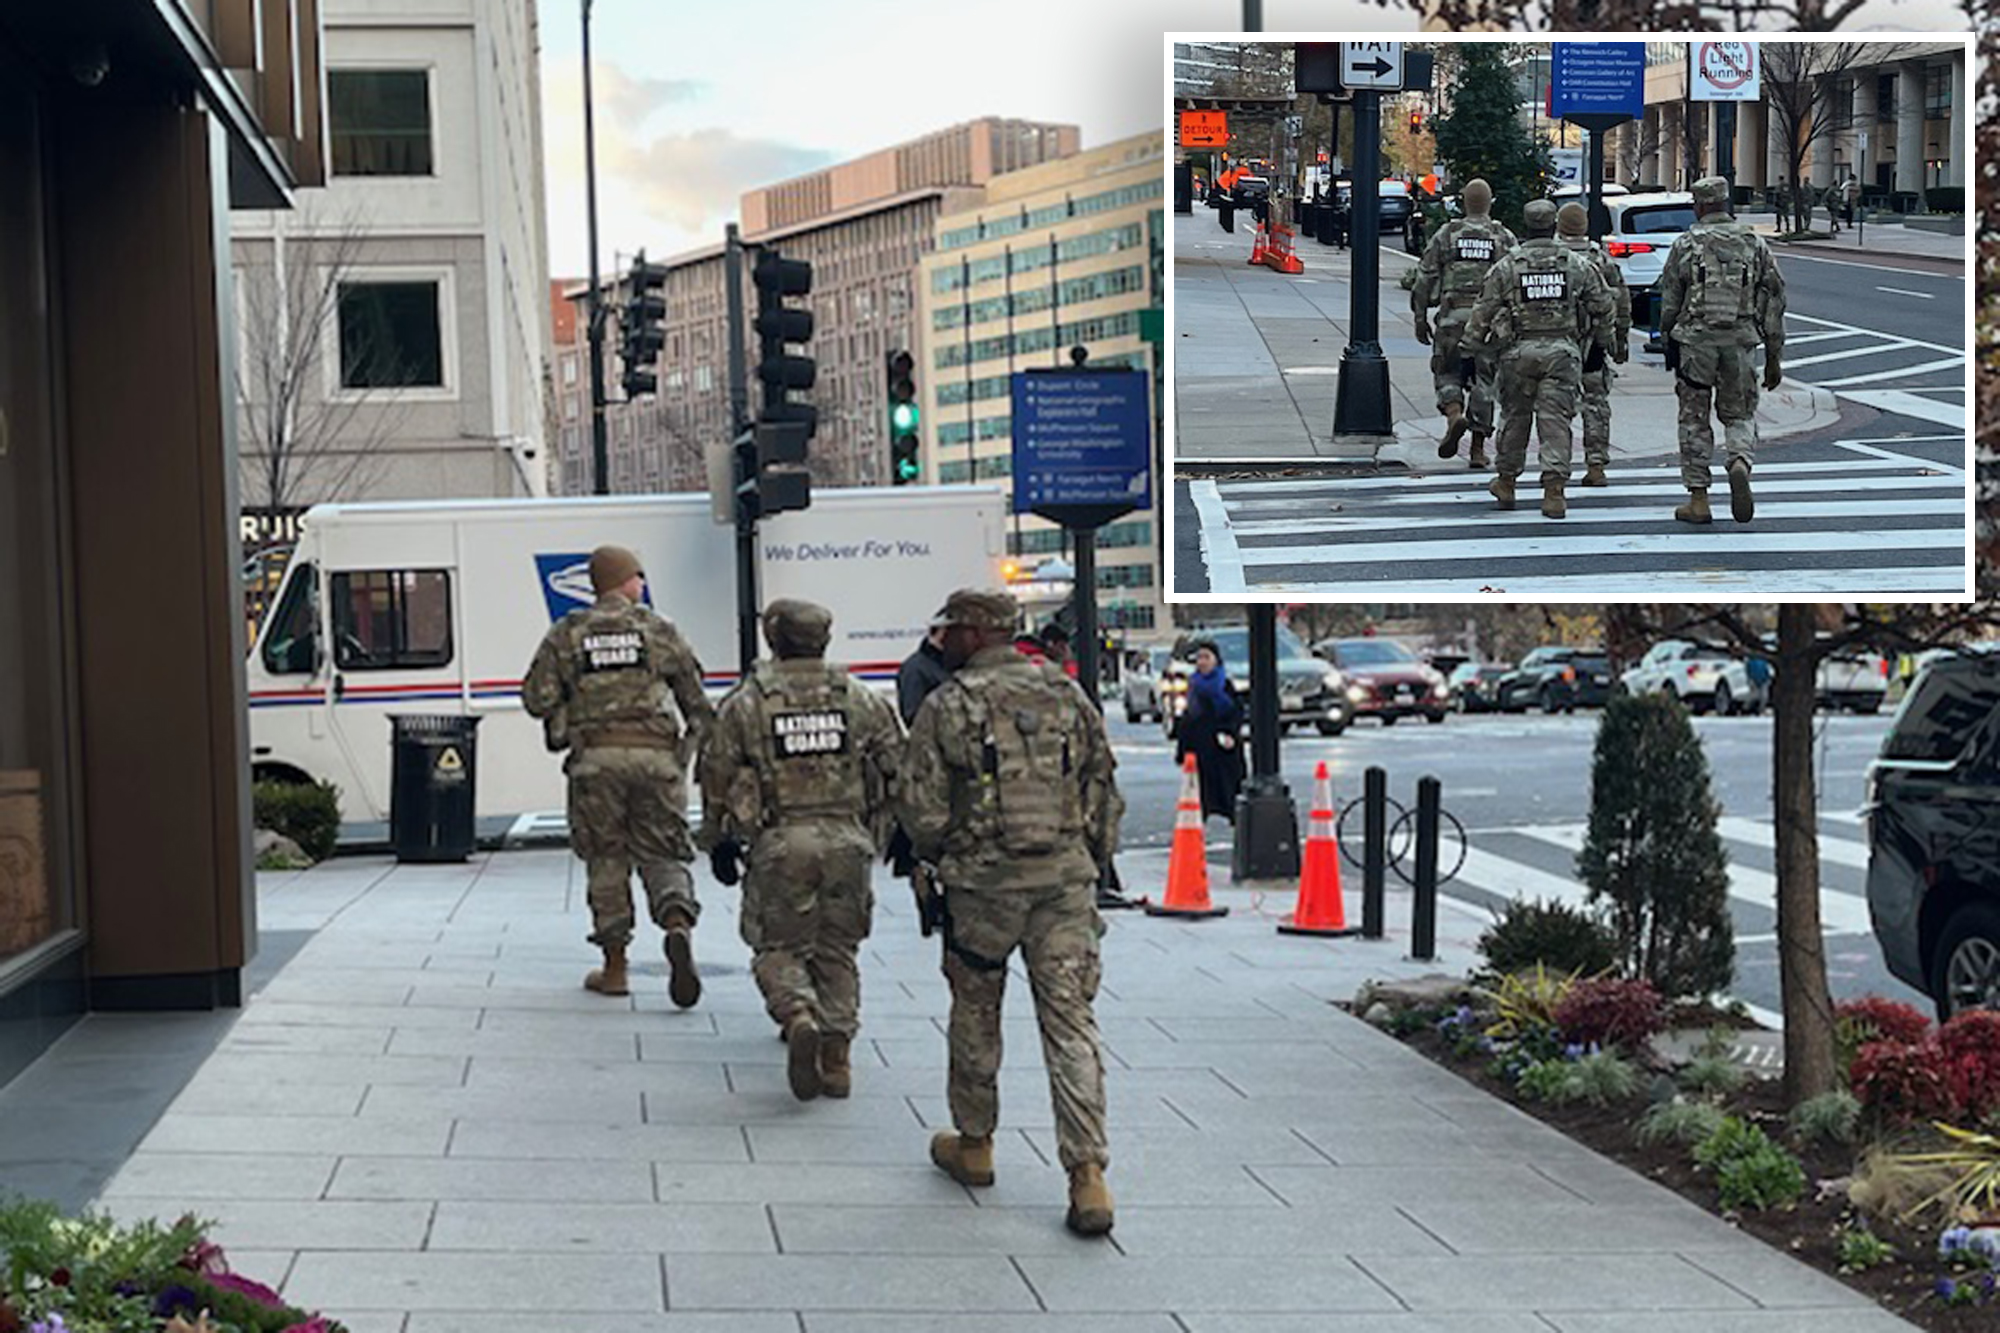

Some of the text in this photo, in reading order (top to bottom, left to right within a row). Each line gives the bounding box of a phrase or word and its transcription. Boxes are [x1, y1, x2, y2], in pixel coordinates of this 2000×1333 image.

[1710, 52, 1744, 67] Light
[1699, 66, 1753, 81] Running
[1184, 126, 1222, 134] DETOUR
[1458, 239, 1494, 250] NATIONAL
[1461, 249, 1490, 259] GUARD
[1521, 273, 1566, 287] NATIONAL
[1527, 285, 1562, 299] GUARD
[765, 544, 794, 561] We
[797, 543, 860, 561] Deliver
[862, 540, 893, 559] For
[583, 632, 642, 650] NATIONAL
[591, 647, 639, 668] GUARD
[774, 713, 846, 735] NATIONAL
[784, 731, 841, 753] GUARD
